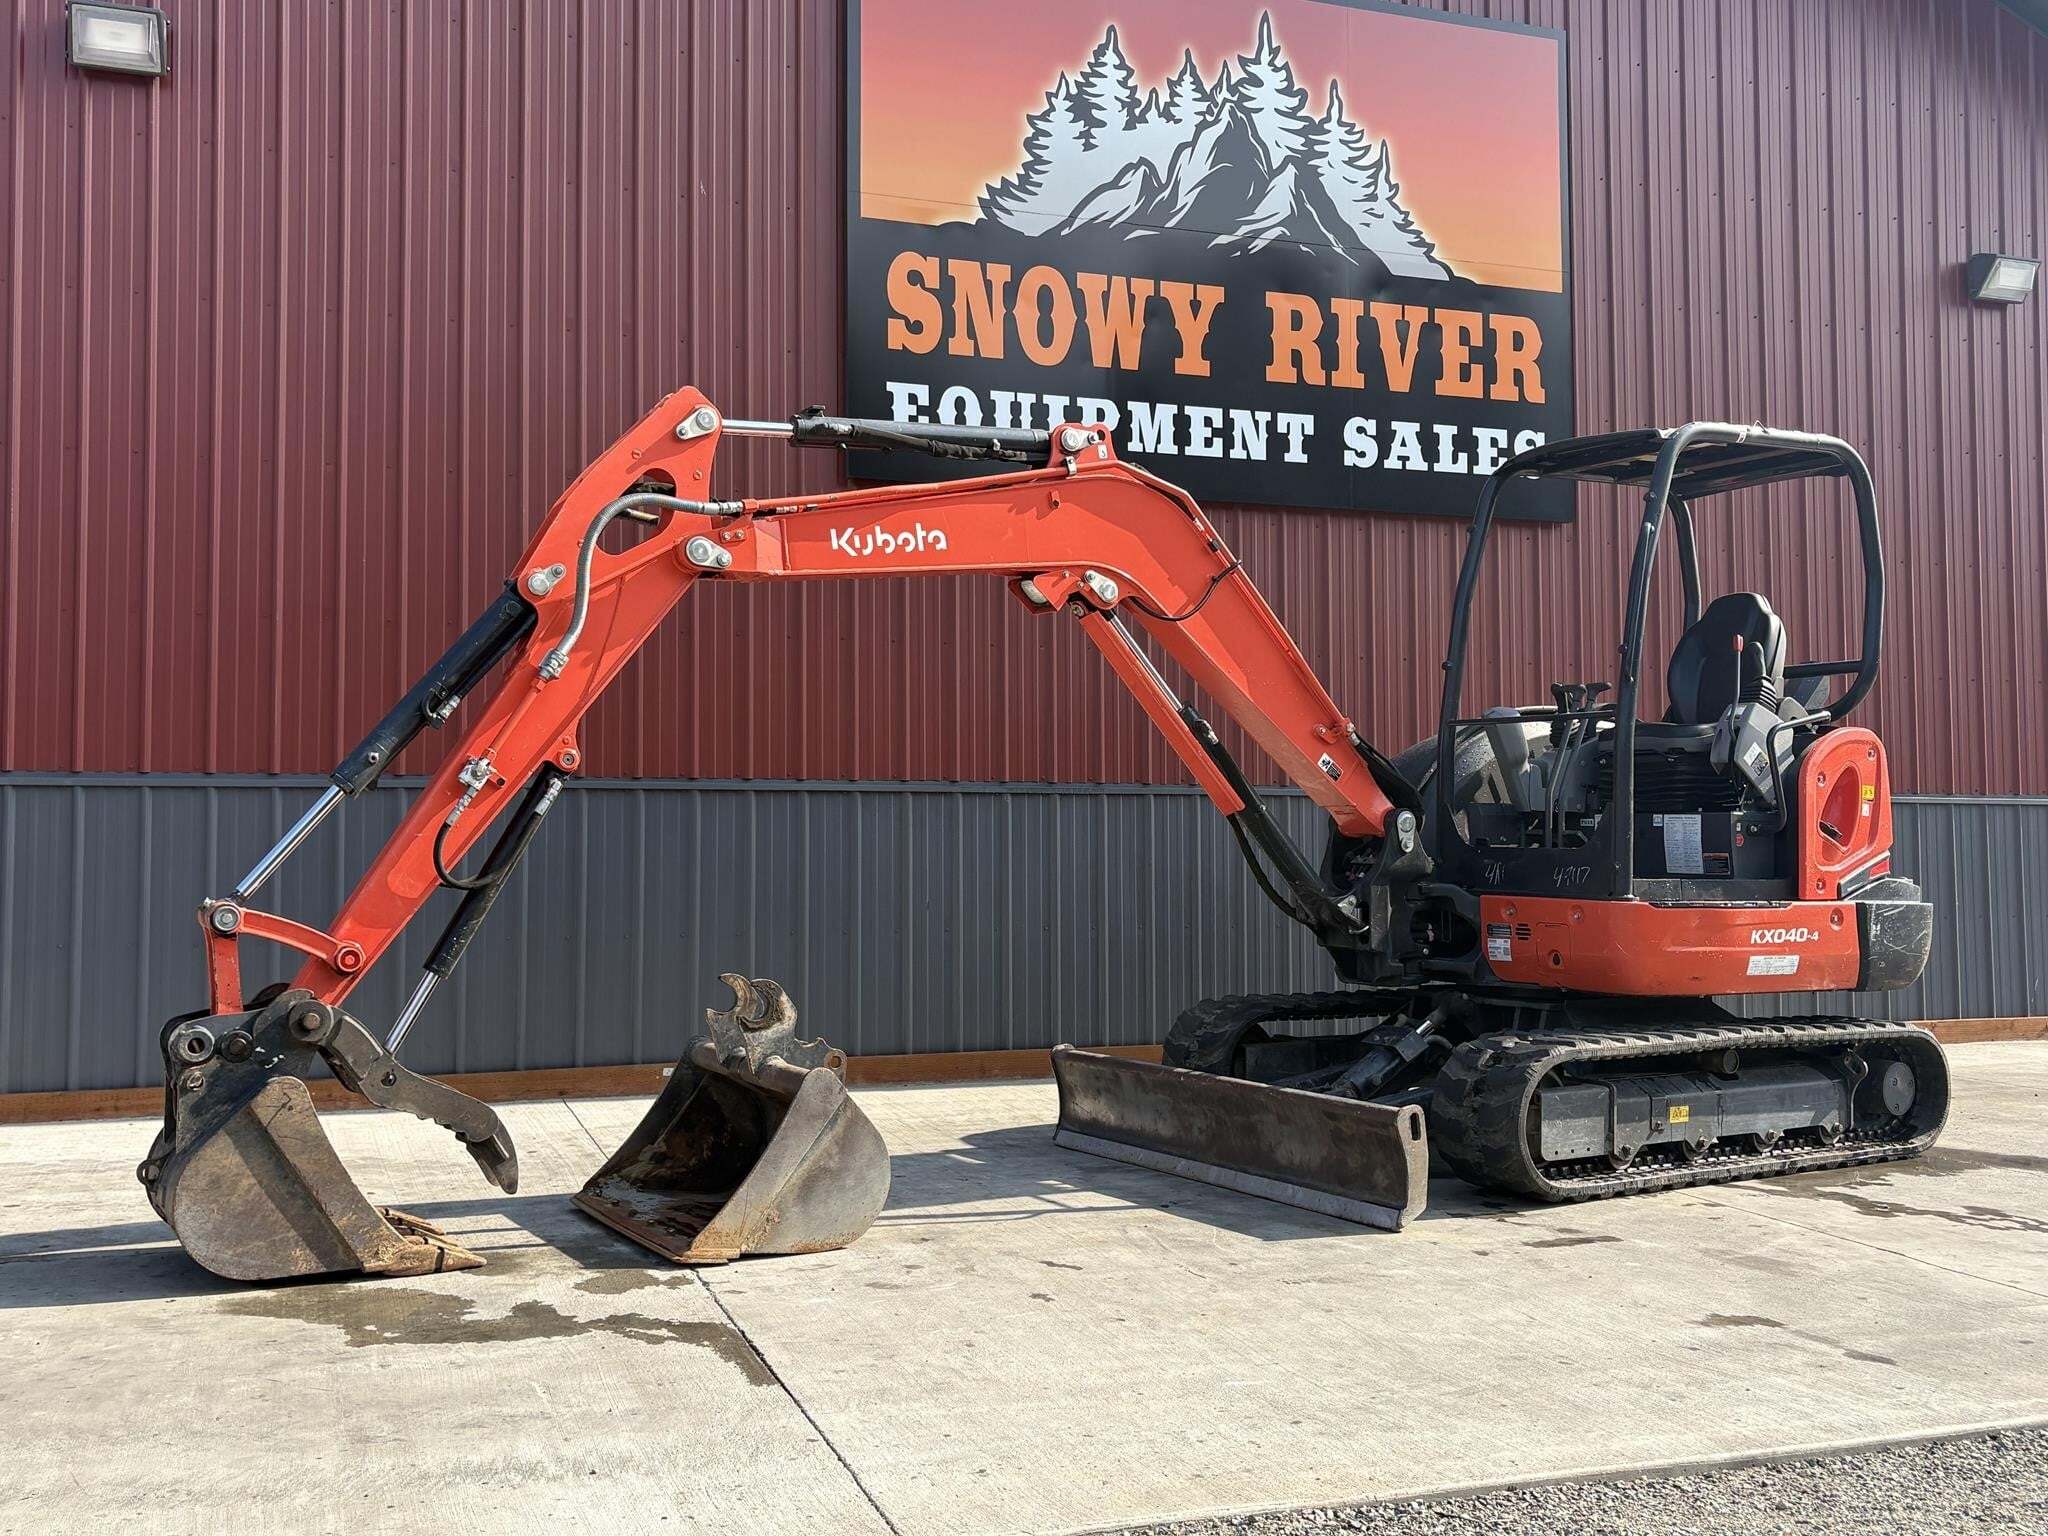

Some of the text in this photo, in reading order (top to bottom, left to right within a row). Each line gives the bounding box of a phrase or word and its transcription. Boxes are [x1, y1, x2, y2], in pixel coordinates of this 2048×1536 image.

[887, 251, 1546, 404] SNOWY RIVER
[886, 381, 1315, 463] EQUIPMENT
[829, 522, 948, 557] Kubota
[1750, 927, 1819, 944] KX040-4
